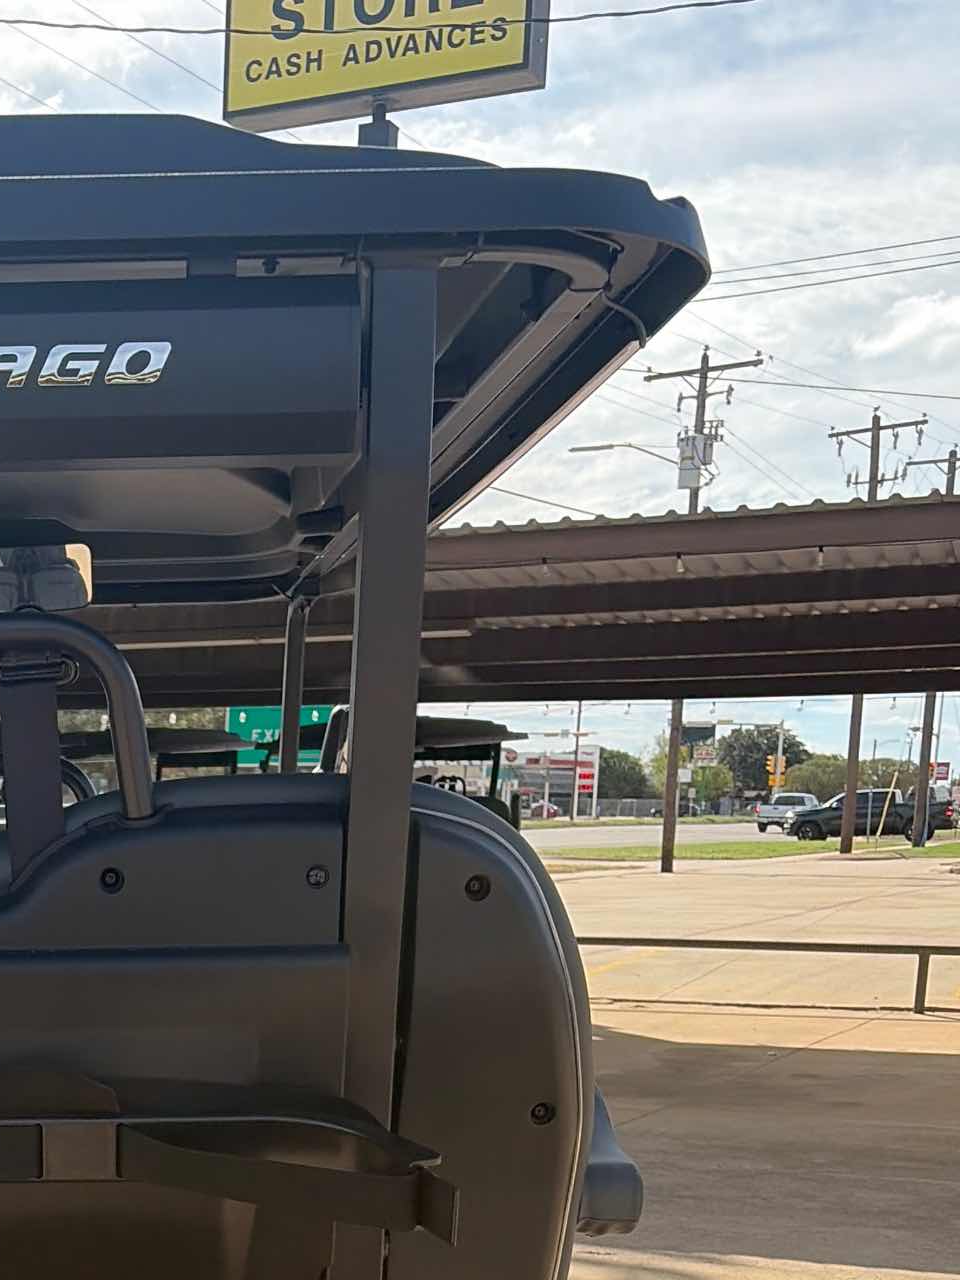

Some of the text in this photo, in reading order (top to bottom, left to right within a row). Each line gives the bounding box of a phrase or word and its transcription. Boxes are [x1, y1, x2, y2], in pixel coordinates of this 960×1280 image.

[271, 0, 484, 40] STO
[245, 17, 509, 83] CASH ADVANCES
[251, 728, 280, 743] EXI
